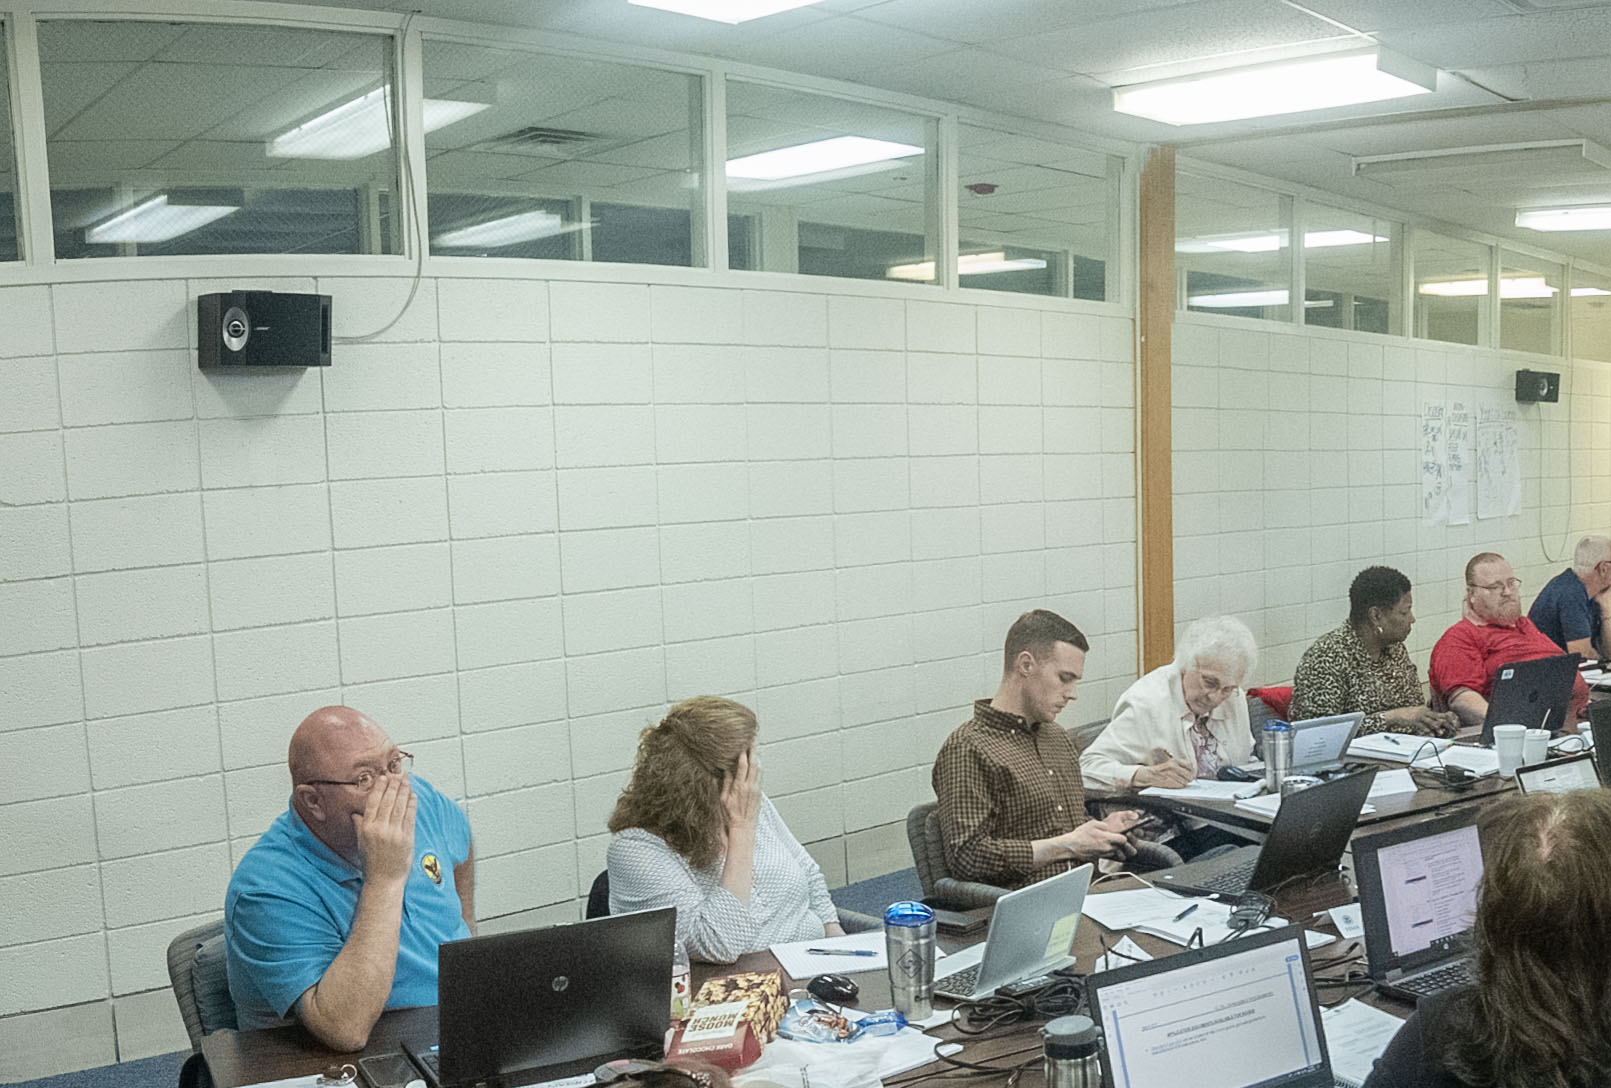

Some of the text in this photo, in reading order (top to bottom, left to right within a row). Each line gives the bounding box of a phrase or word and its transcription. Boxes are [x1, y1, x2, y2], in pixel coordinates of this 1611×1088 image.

[692, 1012, 738, 1025] MUNCH
[688, 1020, 735, 1032] MOOSE
[678, 1043, 733, 1055] DARK CHOCOLATE
